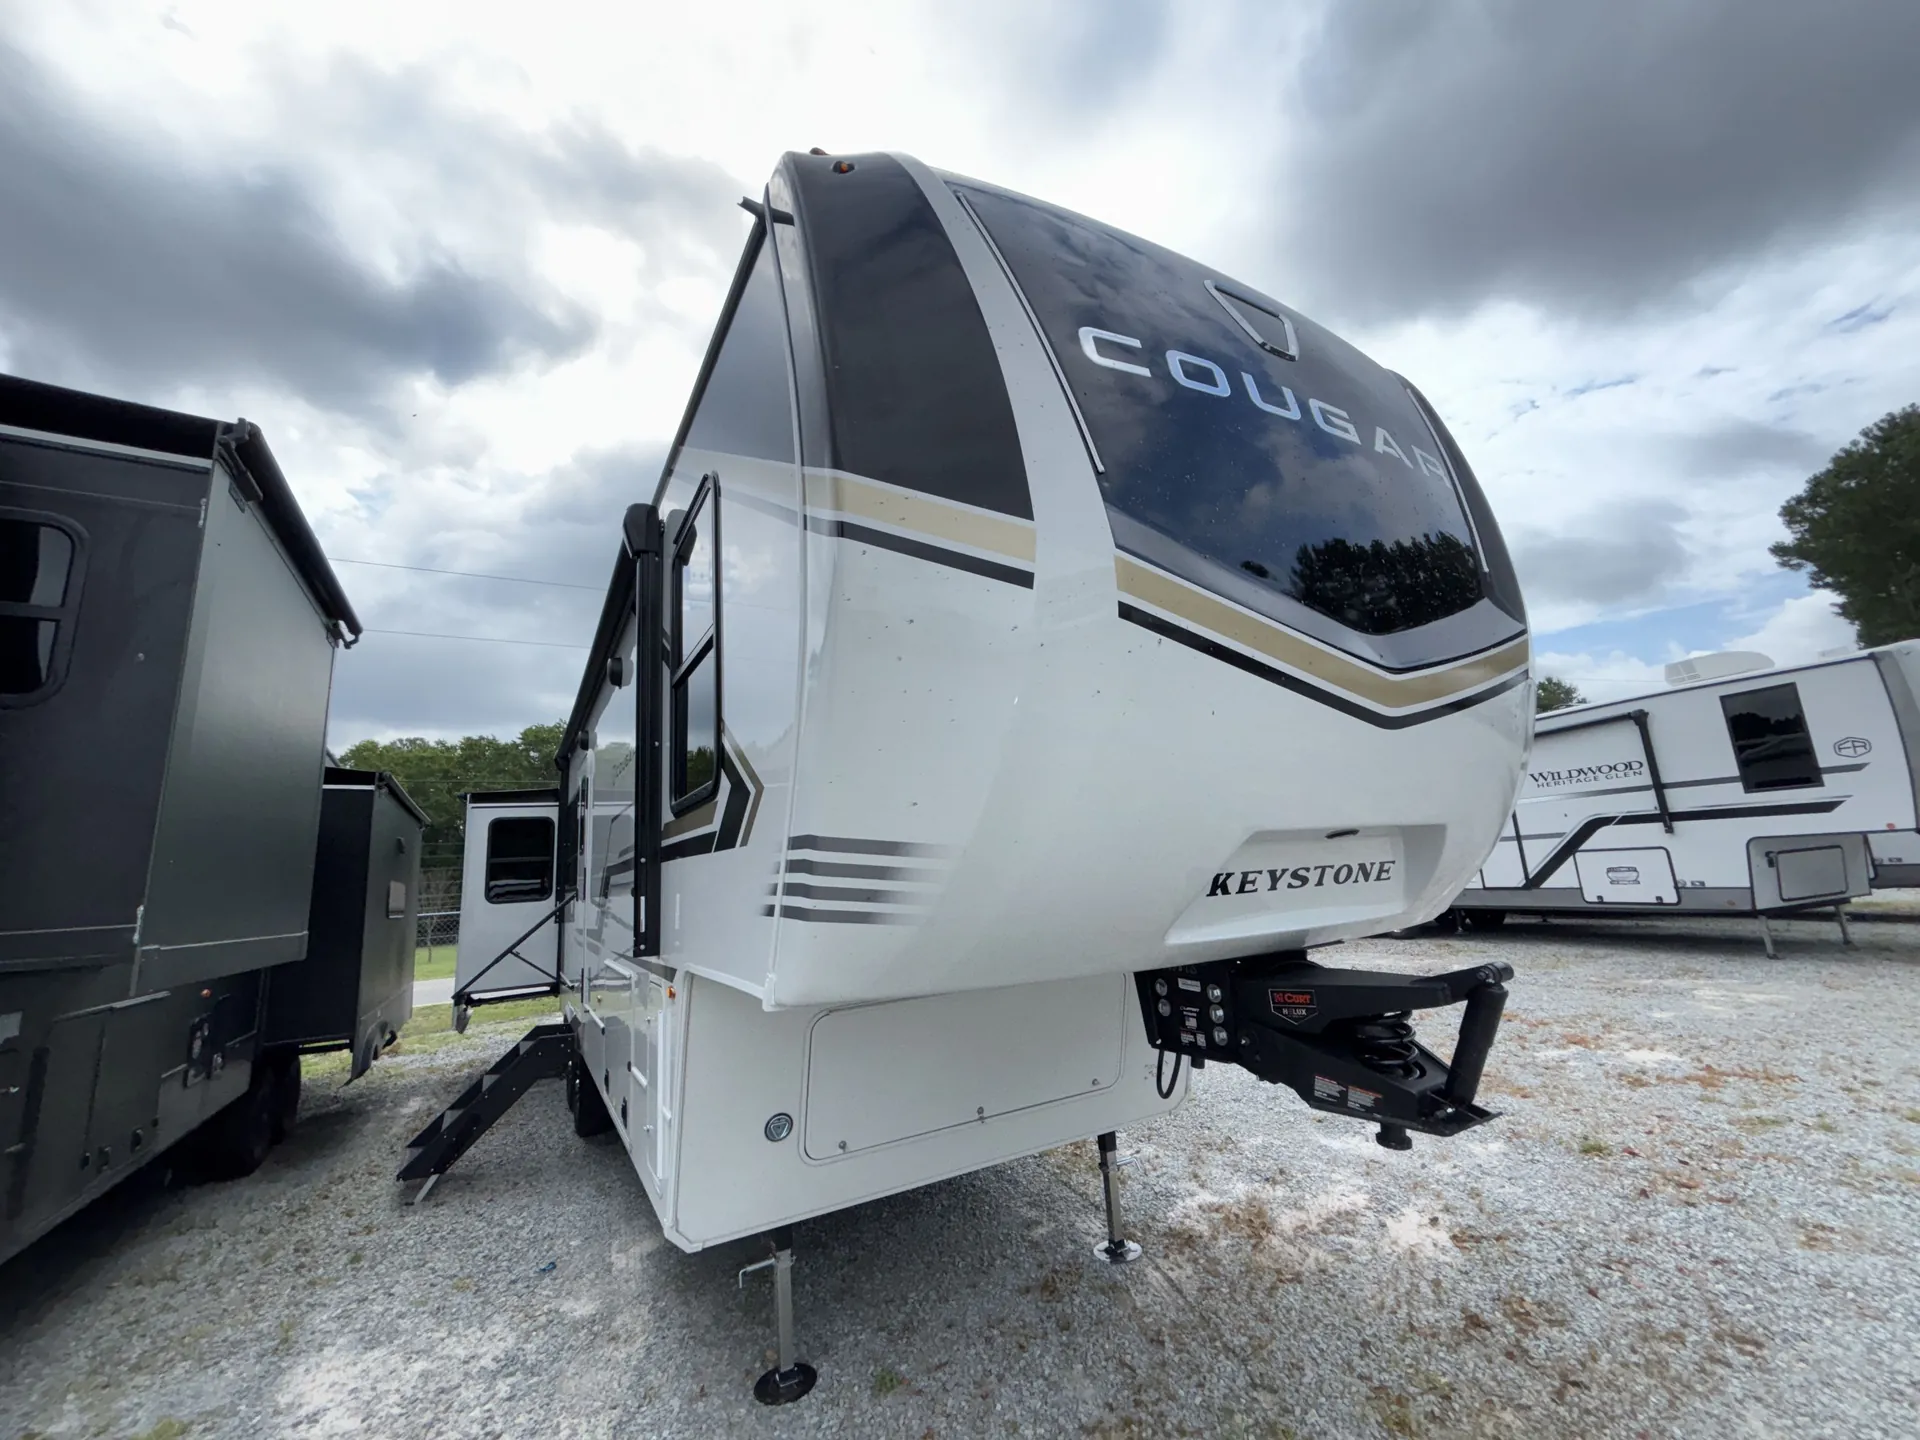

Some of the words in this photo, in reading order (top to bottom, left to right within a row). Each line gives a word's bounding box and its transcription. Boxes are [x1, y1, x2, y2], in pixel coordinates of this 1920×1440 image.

[1078, 326, 1451, 489] COUGAR
[1529, 760, 1644, 783] WILDWOOD
[1537, 775, 1600, 788] HERITAGE
[1605, 770, 1643, 780] GLEN
[1206, 860, 1396, 897] KEYSTONE
